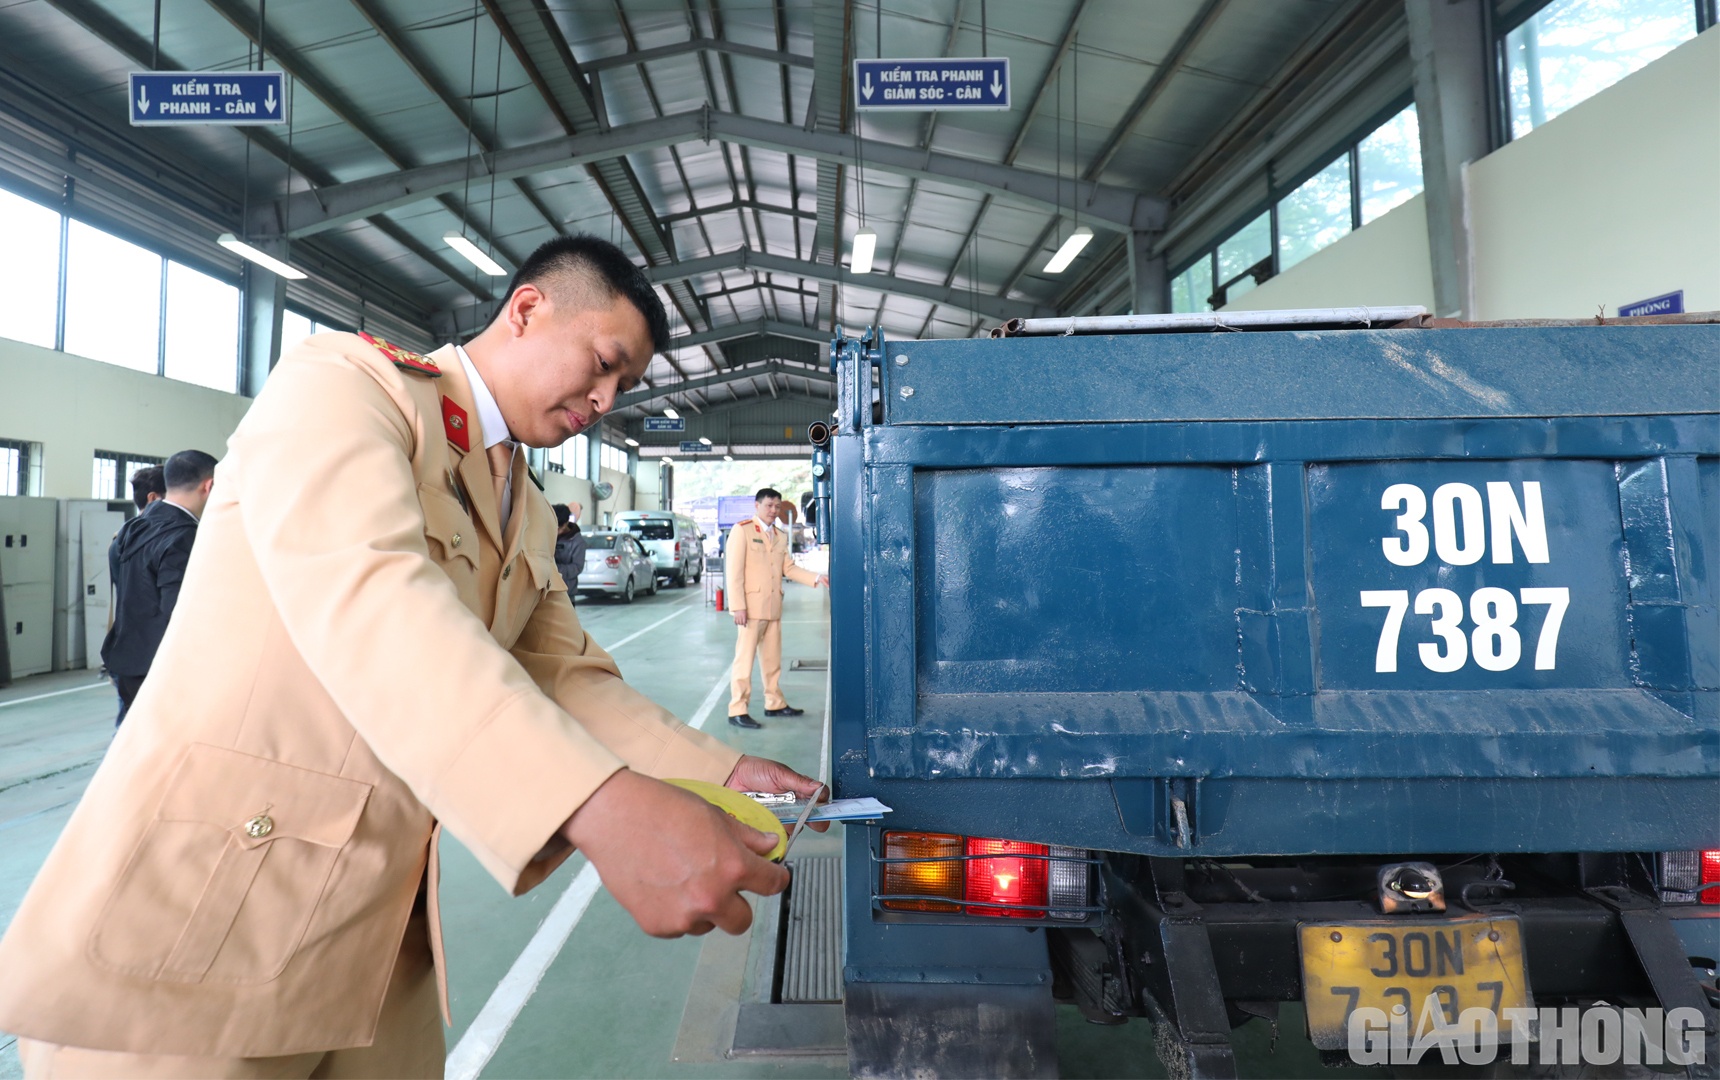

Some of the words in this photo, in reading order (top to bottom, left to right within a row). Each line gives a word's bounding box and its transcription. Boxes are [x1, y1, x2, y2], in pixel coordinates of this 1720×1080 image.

[172, 78, 210, 96] KIỂM
[213, 83, 242, 96] TRA
[880, 66, 912, 82] KIỂM
[915, 70, 939, 82] TRA
[941, 69, 984, 82] PHANH
[159, 101, 211, 114] PHANH
[225, 99, 256, 114] CÂN
[884, 84, 916, 100] GIẢM
[919, 85, 944, 99] SÓC
[955, 85, 982, 99] CÂN
[1381, 481, 1550, 567] 30N
[1360, 587, 1570, 673] 7387
[1368, 930, 1465, 978] 30N
[1330, 981, 1504, 1032] 7387
